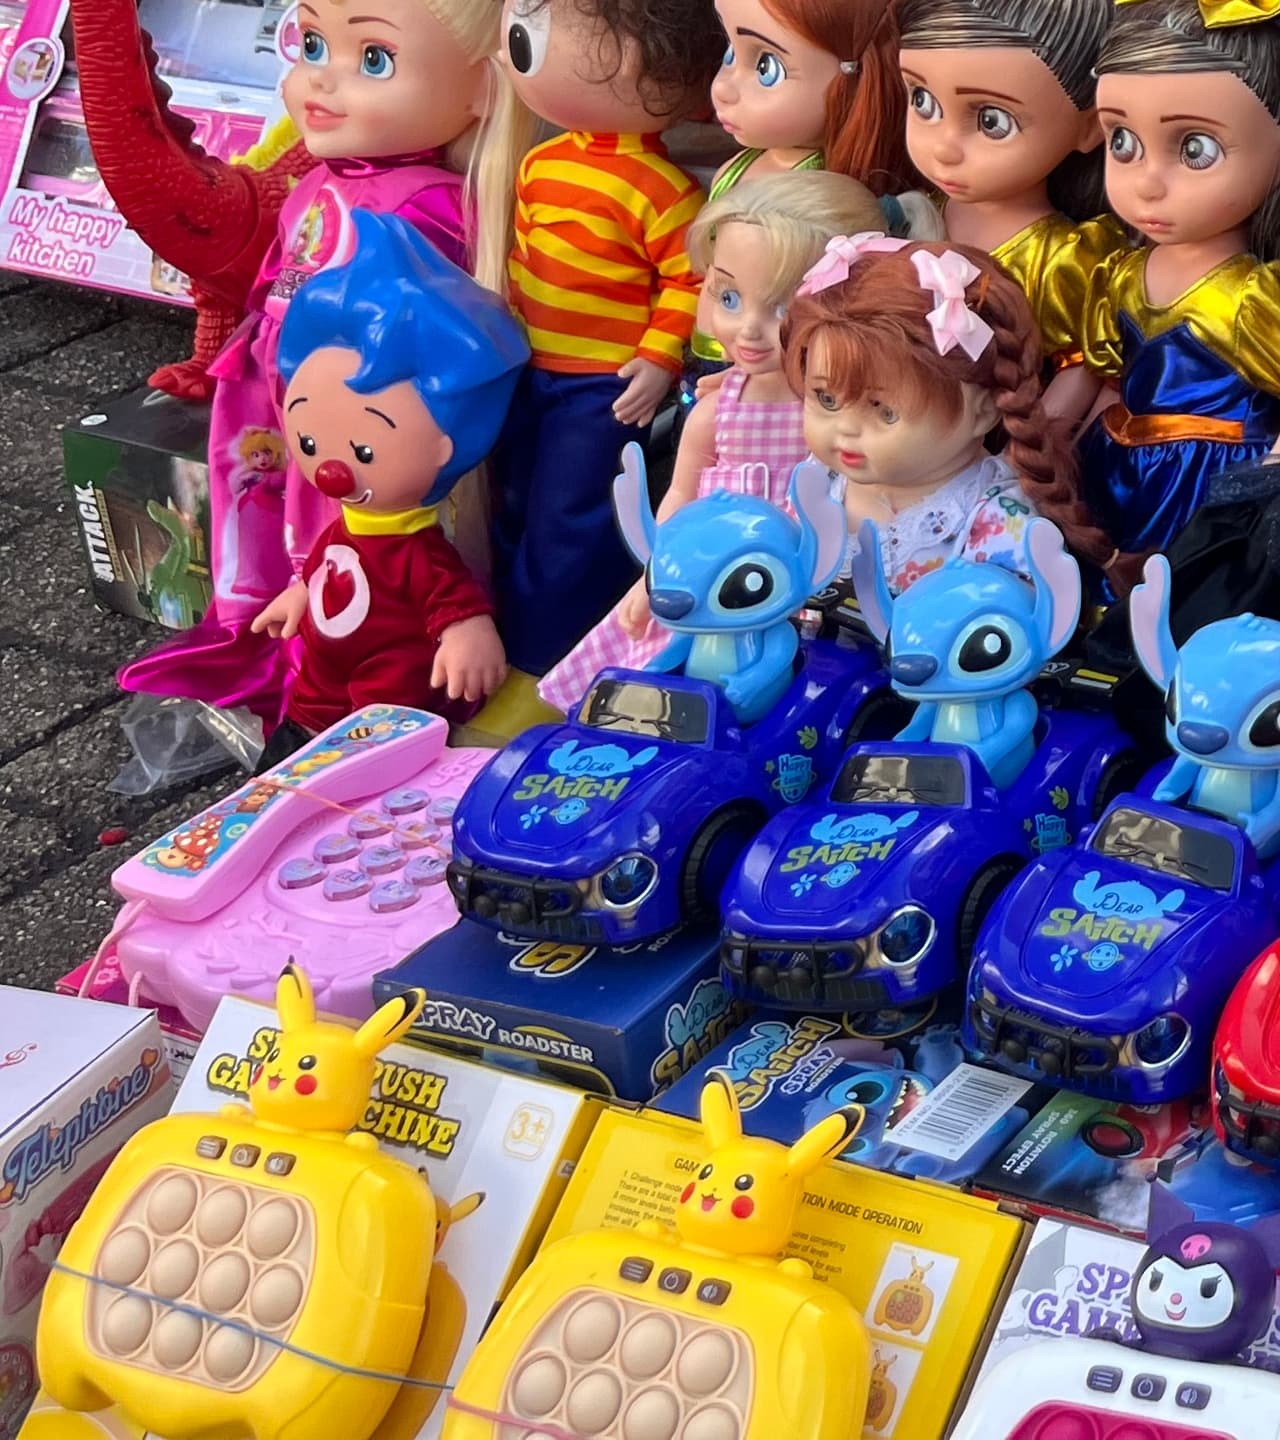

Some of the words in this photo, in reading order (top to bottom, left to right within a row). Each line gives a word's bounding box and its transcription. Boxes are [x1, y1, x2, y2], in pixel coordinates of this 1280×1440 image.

[10, 197, 47, 232] My
[48, 203, 125, 248] happy
[8, 233, 96, 277] kitchen
[566, 754, 615, 773] DEAR
[829, 823, 879, 841] DEAR
[1093, 891, 1143, 916] DEAR
[498, 1030, 594, 1063] ROADSTER
[781, 1047, 836, 1094] SPRAY
[4, 1061, 150, 1192] Telephone
[511, 1109, 547, 1146] 3+
[1001, 1140, 1035, 1172] EFFECT
[828, 1200, 858, 1220] MODE
[863, 1209, 924, 1235] OPERATION
